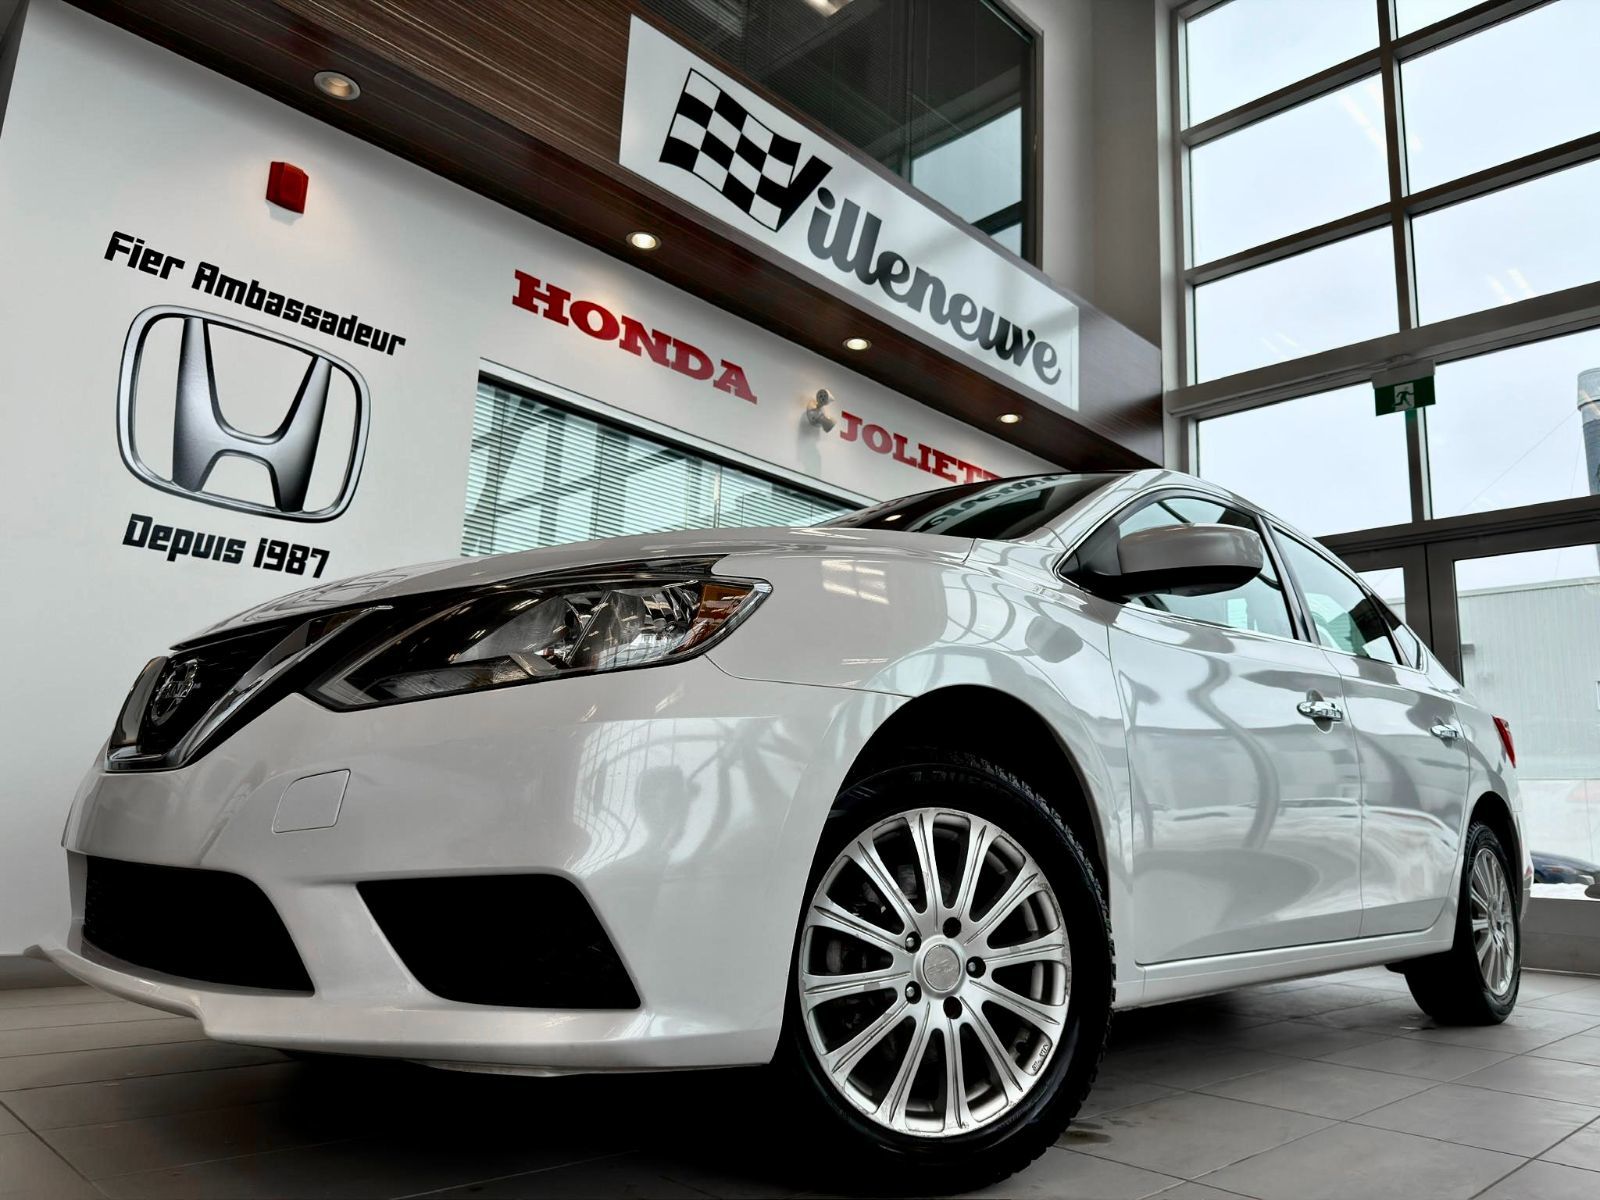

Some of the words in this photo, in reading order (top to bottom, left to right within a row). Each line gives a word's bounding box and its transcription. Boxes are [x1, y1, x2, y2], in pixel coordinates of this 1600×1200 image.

[104, 230, 185, 279] Fier
[191, 261, 407, 356] Ambassadeur
[659, 67, 1062, 386] Villeneuve
[512, 269, 758, 405] HONDA
[839, 410, 1003, 486] JOLIET
[122, 513, 247, 563] Depuis
[252, 537, 331, 579] 1987
